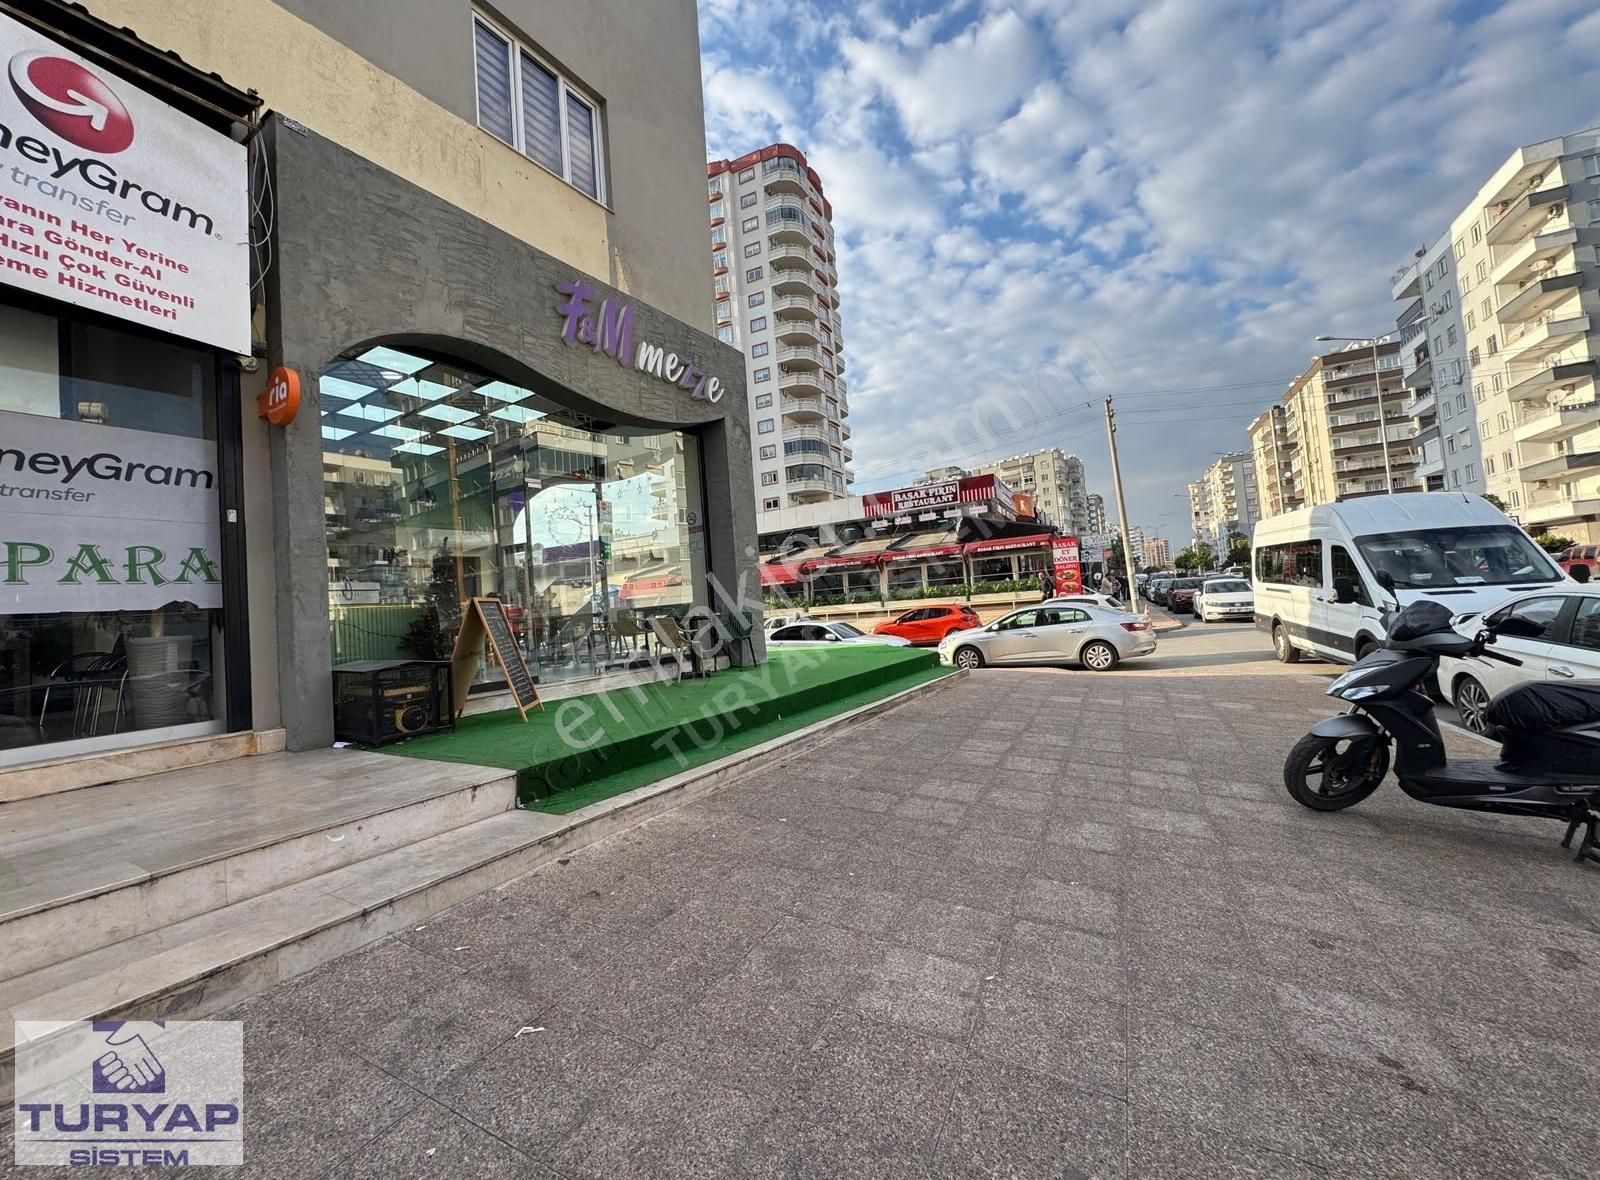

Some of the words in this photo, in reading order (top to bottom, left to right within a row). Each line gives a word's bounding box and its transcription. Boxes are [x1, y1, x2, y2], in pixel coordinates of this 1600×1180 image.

[11, 166, 136, 226] transfer
[0, 195, 61, 227] anın
[71, 219, 114, 245] Her
[121, 239, 189, 273] Yerine
[44, 230, 161, 281] Gönder-Al
[58, 271, 177, 320] Hizmetleri
[59, 254, 106, 280] Çok
[114, 273, 195, 309] Güvenli
[268, 376, 287, 406] ria
[635, 340, 725, 404] mezze
[0, 484, 96, 502] transfer
[897, 494, 954, 509] RESTAURANT
[0, 541, 222, 588] PARA
